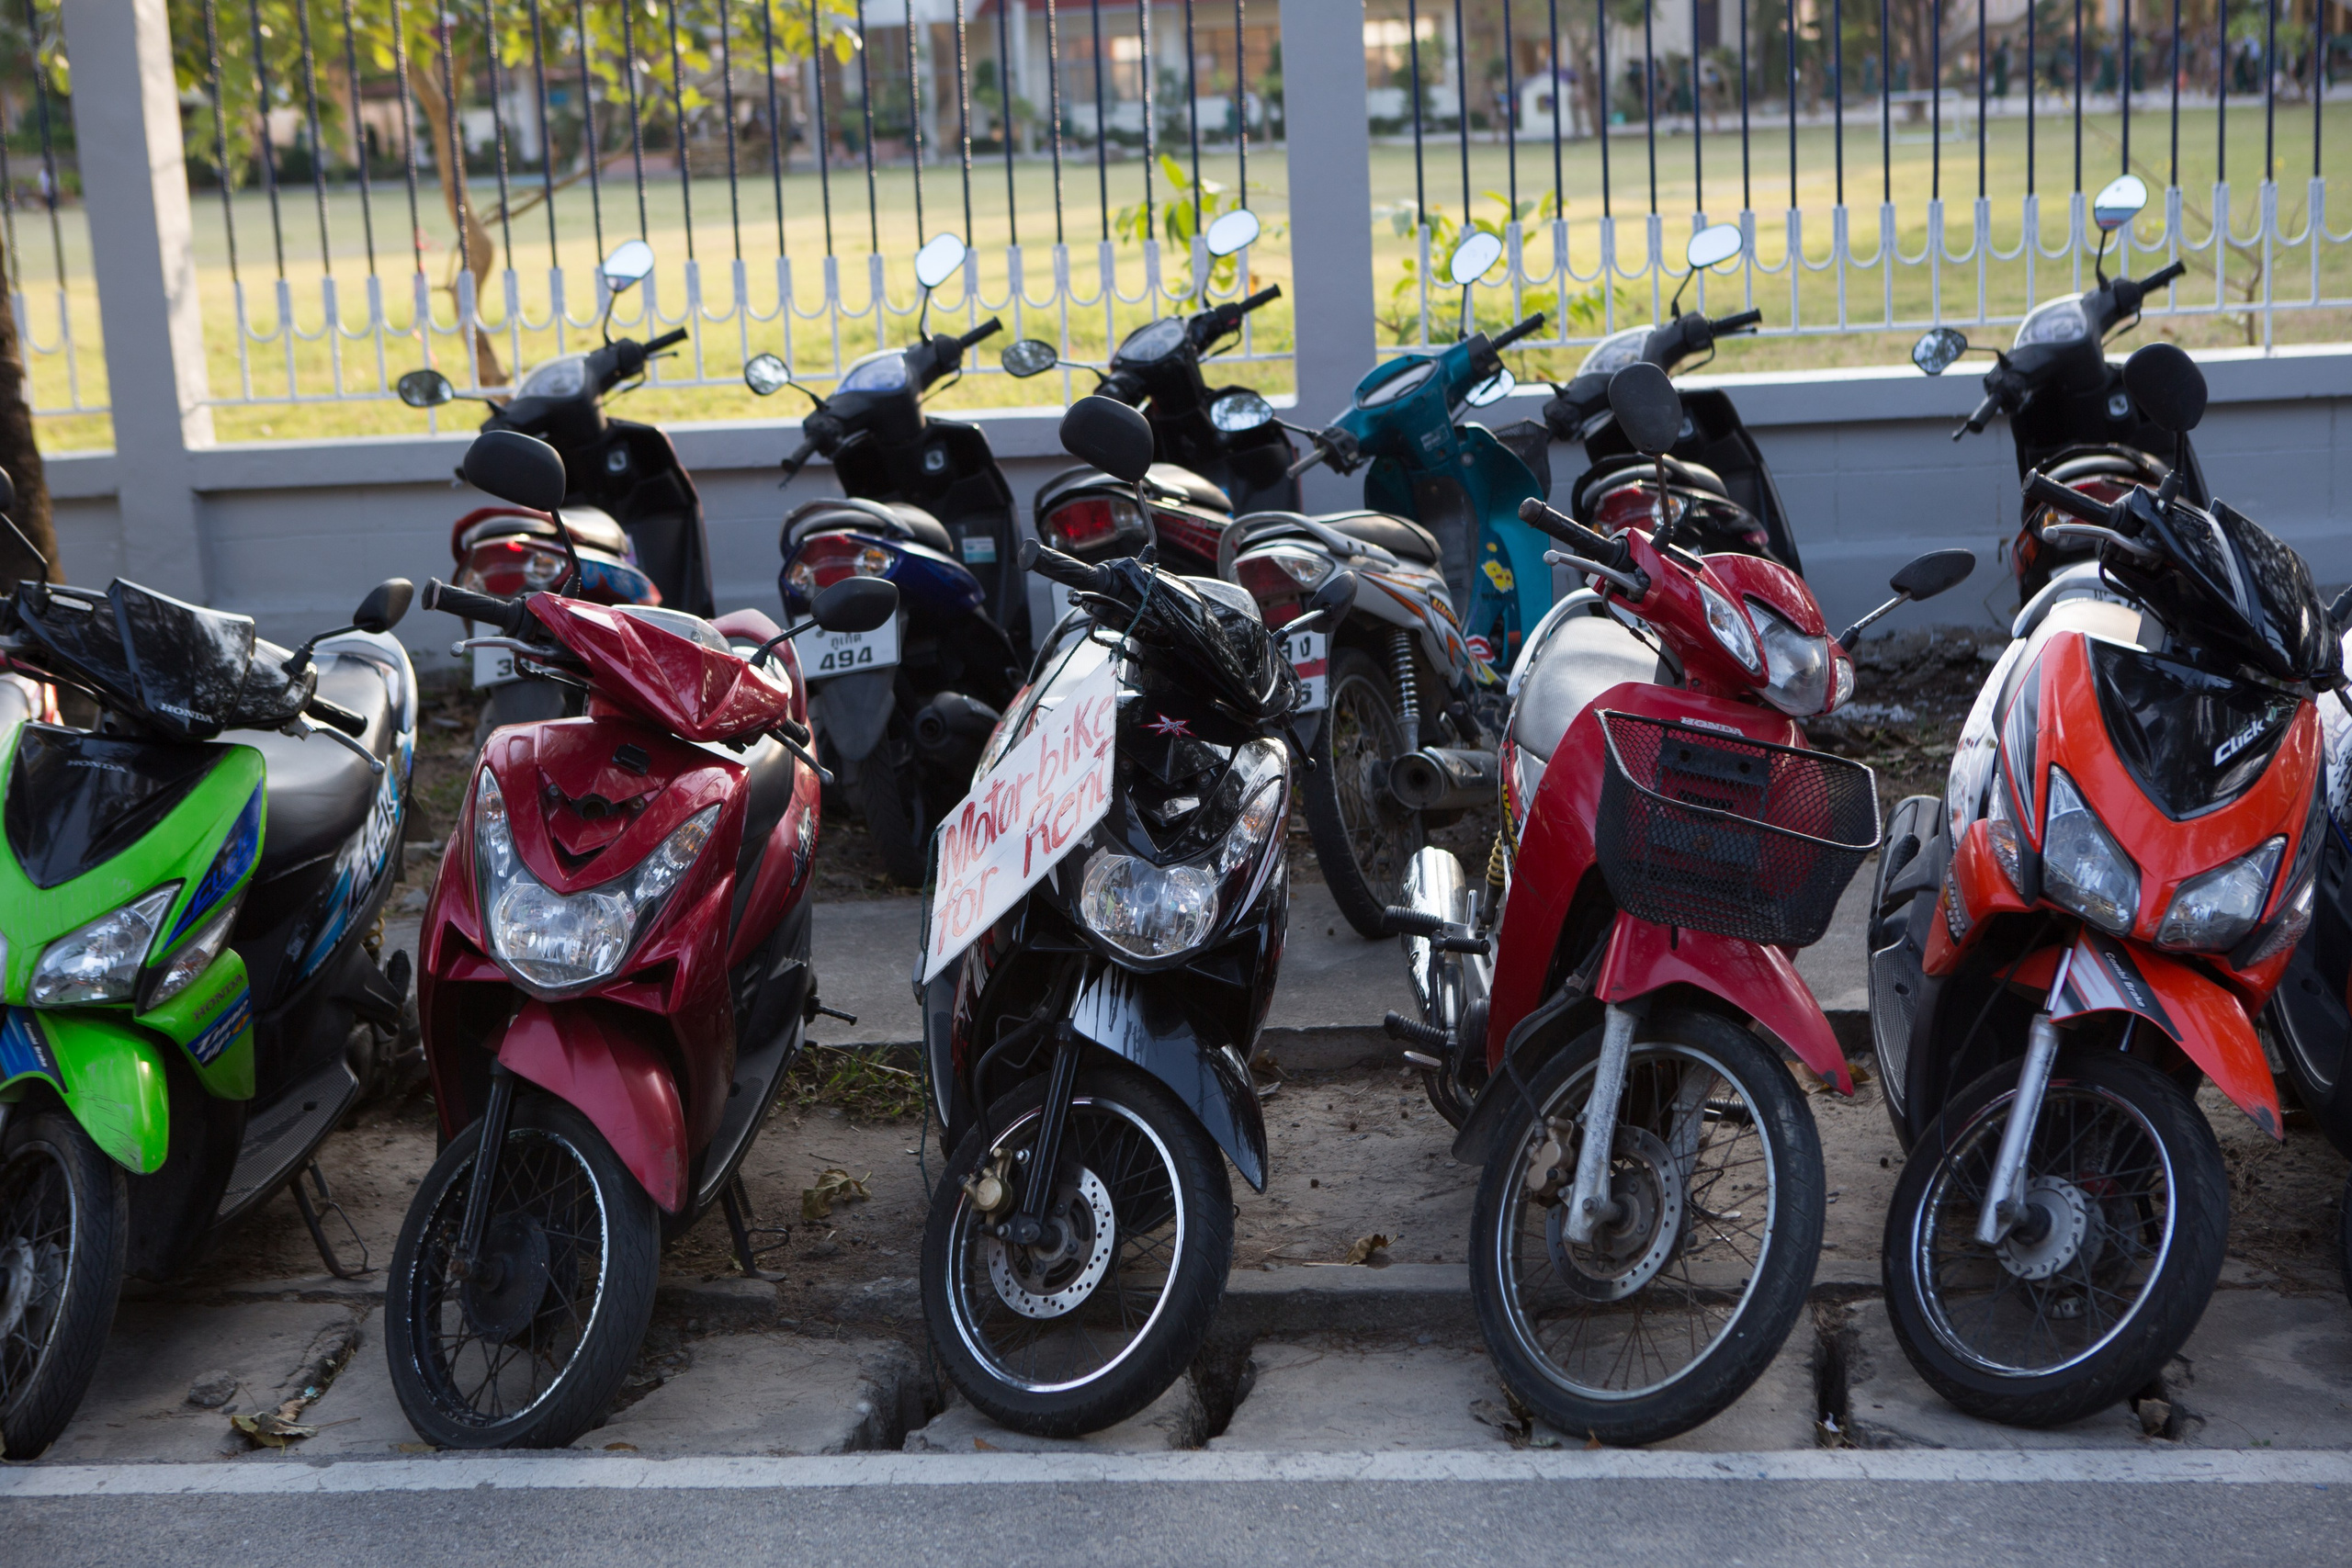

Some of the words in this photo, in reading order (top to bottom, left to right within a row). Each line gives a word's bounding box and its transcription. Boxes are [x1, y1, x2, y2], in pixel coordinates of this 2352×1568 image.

[820, 646, 873, 671] 494
[160, 702, 214, 724] HONDA
[1679, 716, 1745, 737] HONDA
[66, 760, 127, 773] HONDA
[937, 865, 1000, 957] for
[1023, 735, 1114, 879] Rent
[2105, 952, 2131, 980] Combi
[2123, 981, 2146, 1008] Brake
[193, 974, 244, 1021] HONDA
